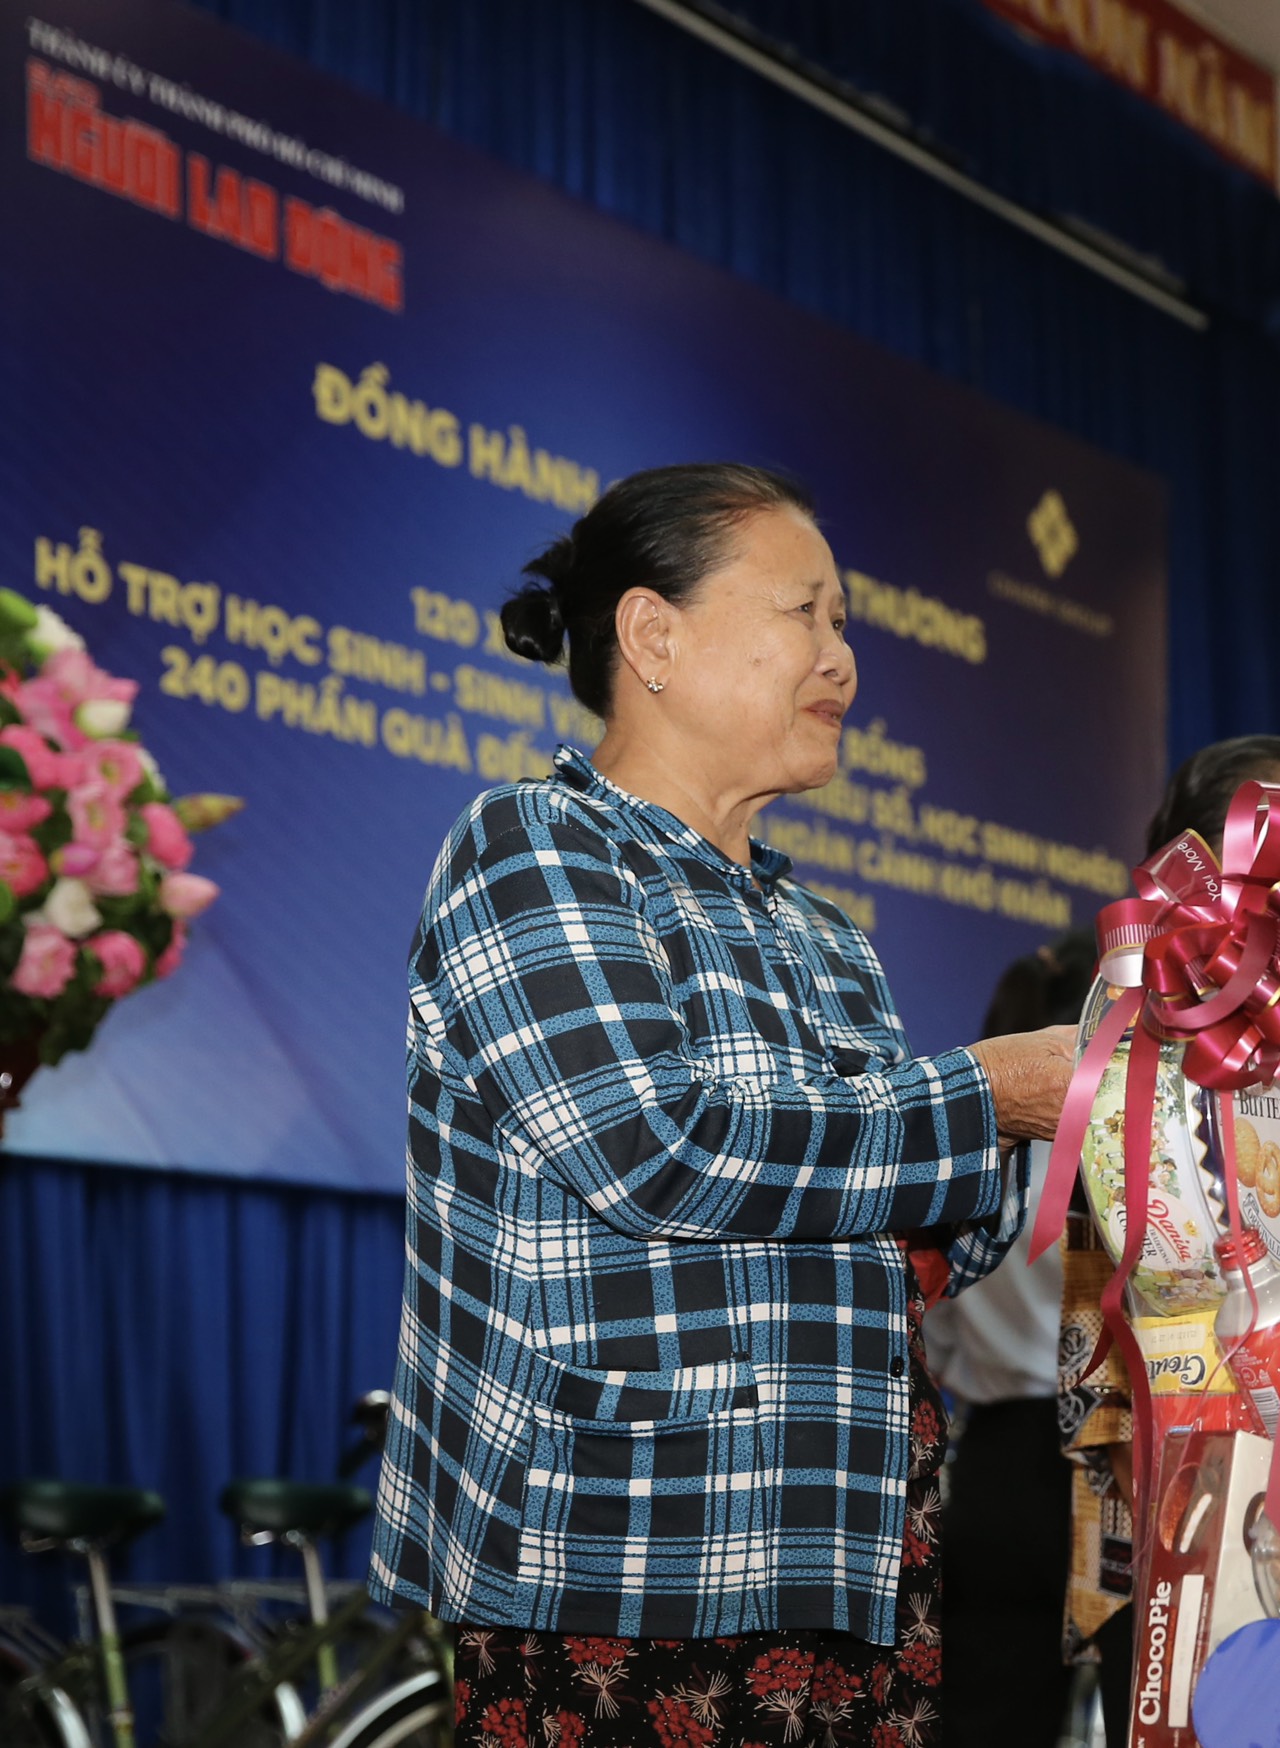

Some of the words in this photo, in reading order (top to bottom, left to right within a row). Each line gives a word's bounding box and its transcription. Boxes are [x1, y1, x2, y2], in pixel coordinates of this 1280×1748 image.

[188, 150, 279, 263] LAO
[312, 361, 463, 469] ĐỒNG
[469, 425, 598, 514] HÀNH
[35, 526, 111, 604] HỖ
[119, 560, 221, 644] TRỢ
[225, 594, 322, 667] HỌC
[327, 626, 427, 694] SINH
[454, 662, 546, 732] SINH
[411, 586, 479, 648] 120
[160, 645, 251, 714] 240
[256, 672, 376, 749] PHẦN
[382, 710, 473, 775] QUÀ
[1177, 842, 1206, 872] More
[1202, 874, 1222, 902] You
